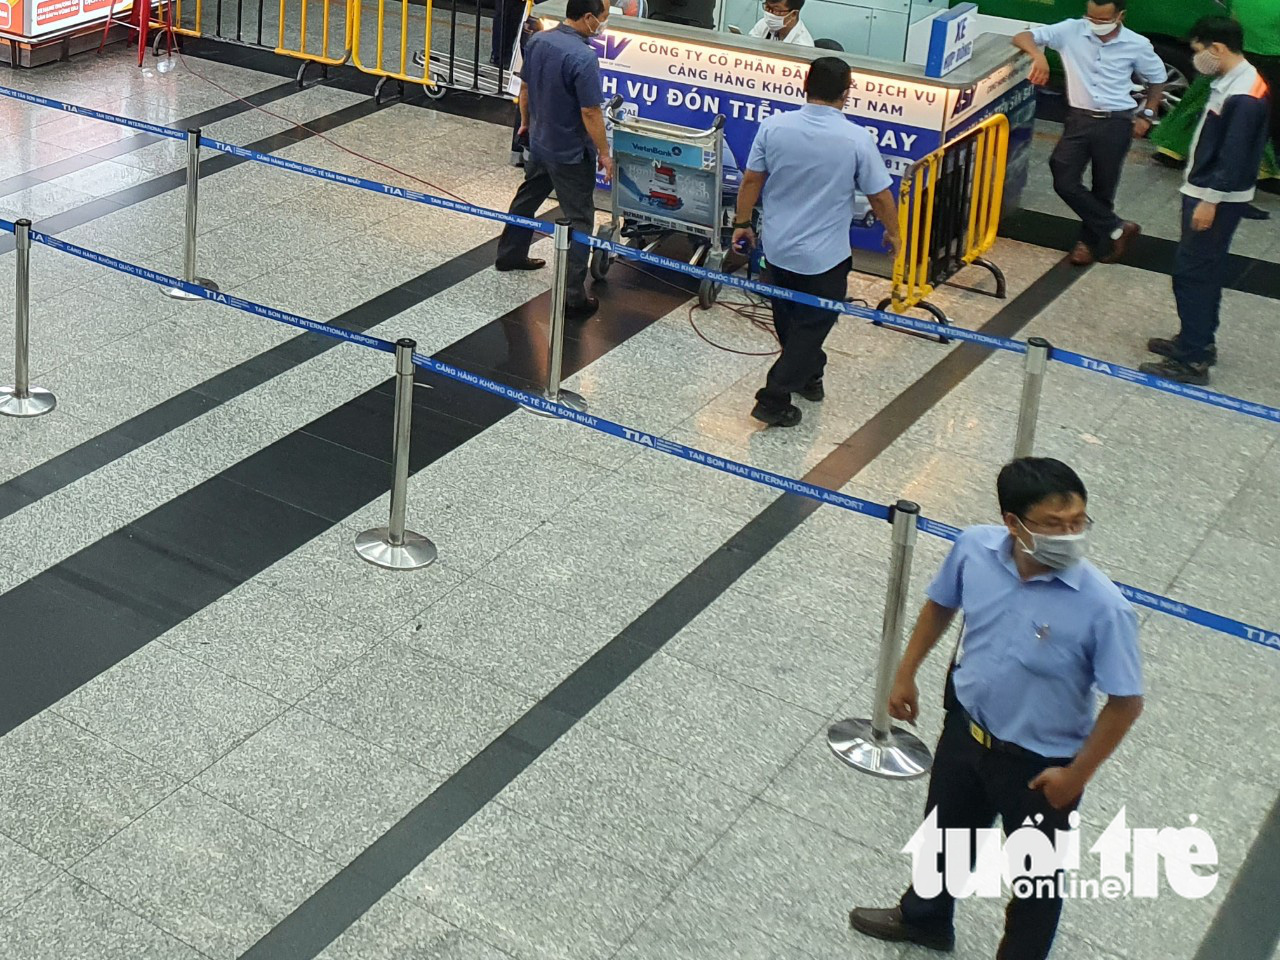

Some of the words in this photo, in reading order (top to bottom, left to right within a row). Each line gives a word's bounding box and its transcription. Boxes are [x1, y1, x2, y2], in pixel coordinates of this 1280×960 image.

[955, 17, 967, 44] XE
[639, 39, 679, 58] CÔNG
[686, 50, 703, 63] TY
[709, 49, 728, 66] CỔ
[734, 55, 775, 75] PHẦN
[850, 79, 859, 90] &
[865, 81, 909, 101] DỊCH
[914, 90, 937, 109] VỤ
[626, 81, 658, 107] VỤ
[667, 84, 720, 115] ĐÓN
[668, 61, 708, 82] CẢNG
[715, 70, 756, 91] HÀNG
[762, 78, 806, 98] KHÔN
[867, 100, 904, 117] NAM
[61, 102, 78, 114] TIA
[215, 142, 232, 153] TIA
[632, 142, 672, 158] VietinBank
[382, 185, 403, 197] TIA
[442, 200, 455, 208] SON
[455, 203, 470, 211] NHAT
[471, 206, 515, 222] INTERNATIONAL
[516, 217, 542, 228] AIRPORT
[588, 237, 611, 251] TIA
[639, 251, 659, 264] CẢNG
[660, 257, 680, 269] HÀNG
[681, 263, 706, 276] KHÔNG
[708, 270, 729, 283] QUỐC
[730, 275, 739, 285] TẾ
[740, 278, 755, 289] TÂN
[756, 283, 771, 294] SƠN
[772, 288, 794, 299] NHẤT
[204, 289, 227, 304] TIA
[818, 297, 846, 312] TIA
[268, 309, 281, 318] SON
[282, 313, 298, 324] NHAT
[299, 318, 349, 338] INTERNATIONAL
[350, 333, 379, 346] AIRPORT
[937, 325, 1001, 346] INTERNATIONAL
[1081, 357, 1112, 374] TIA
[435, 361, 455, 376] CẢNG
[457, 370, 478, 384] HÀNG
[479, 378, 505, 394] KHÔNG
[507, 388, 528, 403] QUỐC
[530, 396, 540, 407] TẾ
[541, 400, 556, 412] TÂN
[558, 407, 575, 419] SƠN
[576, 411, 597, 426] NHẤT
[622, 428, 654, 447] TIA
[688, 450, 705, 462] TAN
[707, 456, 725, 468] SON
[727, 461, 749, 476] NHAT
[751, 469, 821, 497] INTERNATIONAL
[823, 492, 864, 510] AIRPORT
[1243, 626, 1280, 647] TIA
